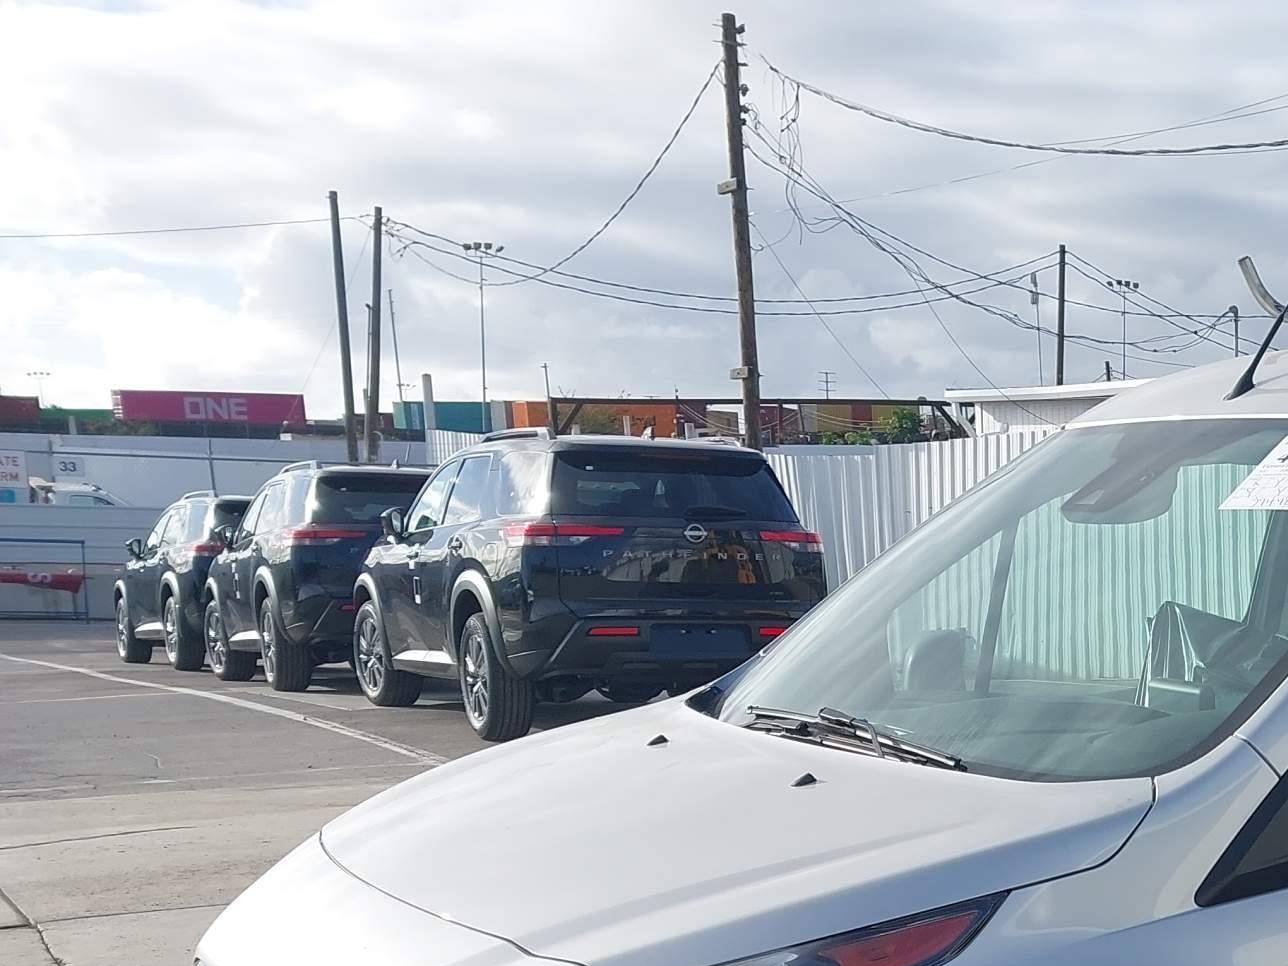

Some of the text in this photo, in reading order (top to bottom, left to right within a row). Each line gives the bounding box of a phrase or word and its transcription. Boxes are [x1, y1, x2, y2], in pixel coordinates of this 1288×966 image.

[183, 397, 248, 420] ONE
[59, 461, 77, 472] 33
[602, 549, 781, 562] PATHFINDER
